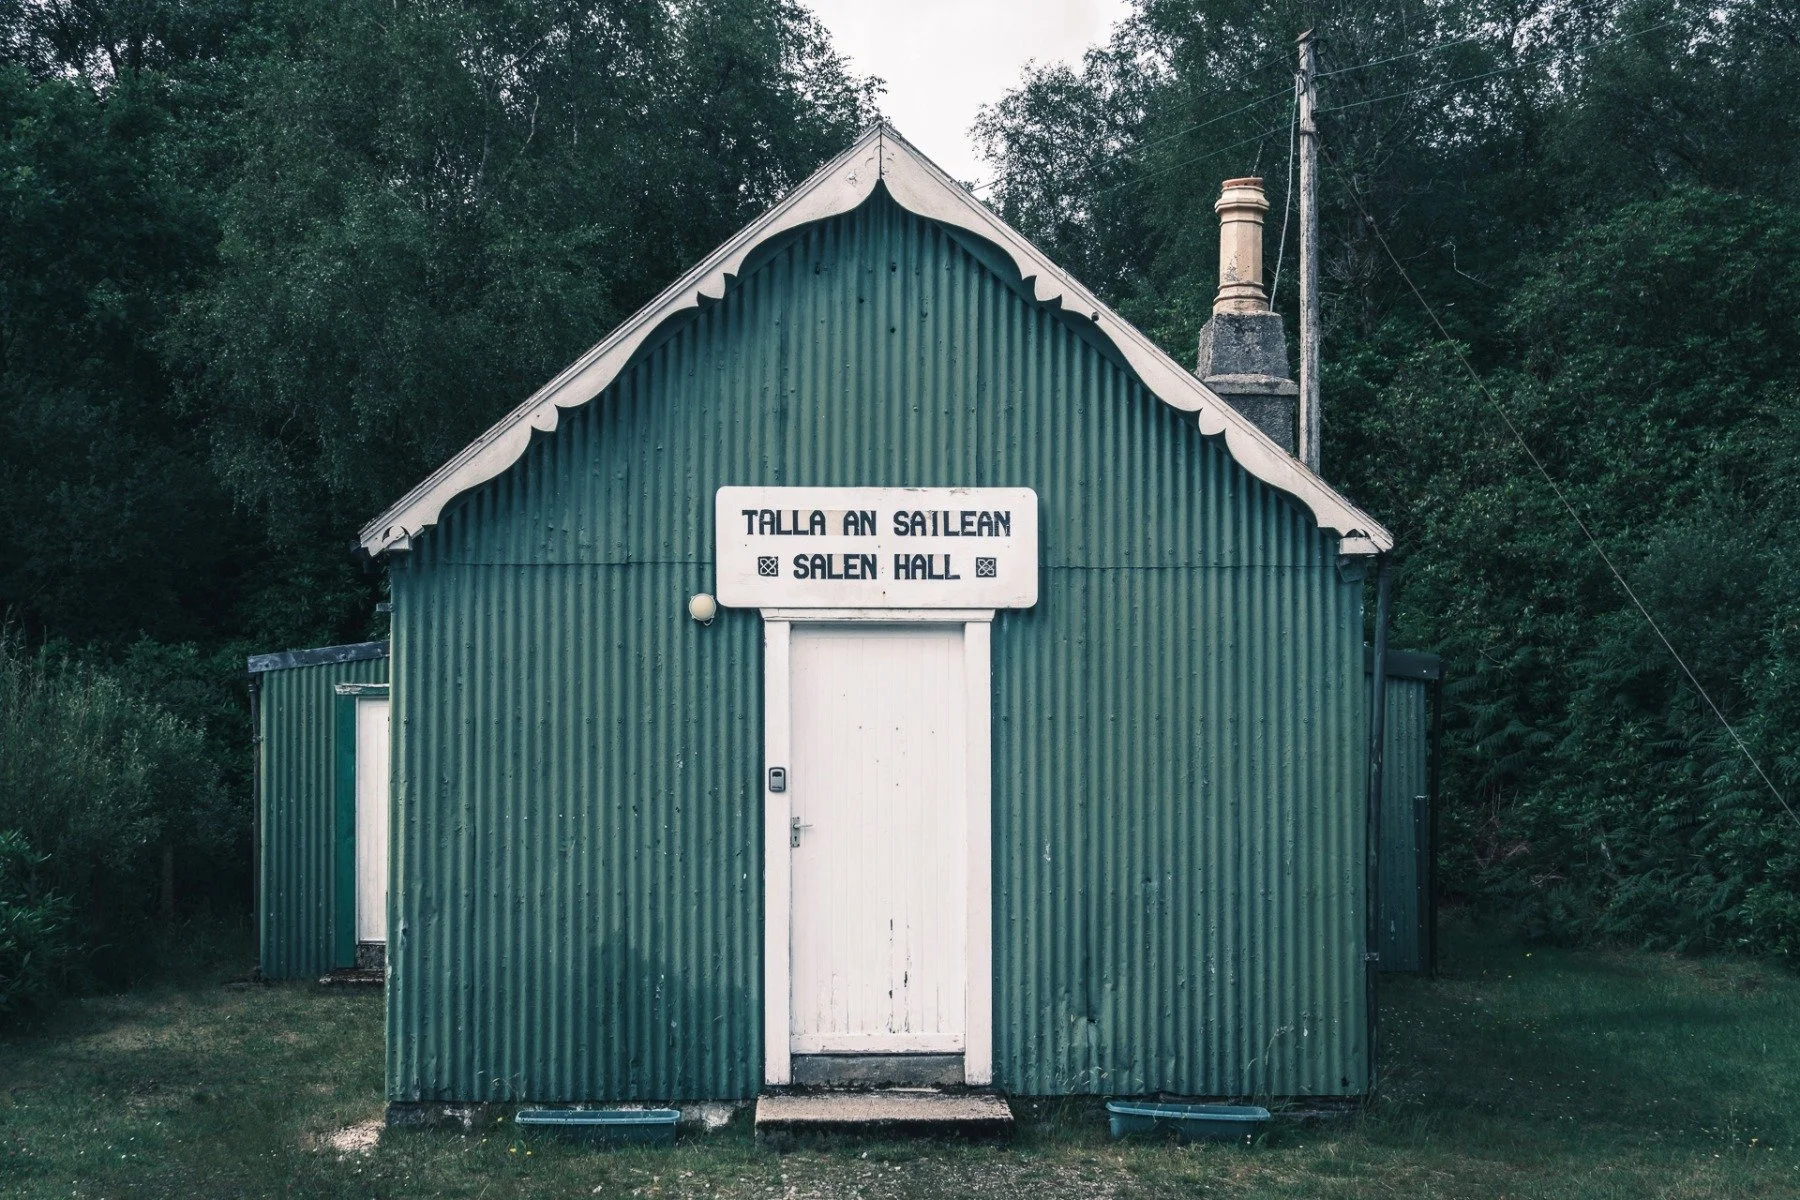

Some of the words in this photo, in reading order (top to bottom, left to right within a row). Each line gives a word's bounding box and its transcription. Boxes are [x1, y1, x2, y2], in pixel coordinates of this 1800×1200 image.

[742, 509, 826, 536] TALLA
[843, 510, 877, 536] AN
[893, 510, 1011, 537] SAILEAN
[793, 553, 877, 580] SALEN
[894, 553, 961, 580] HALL
